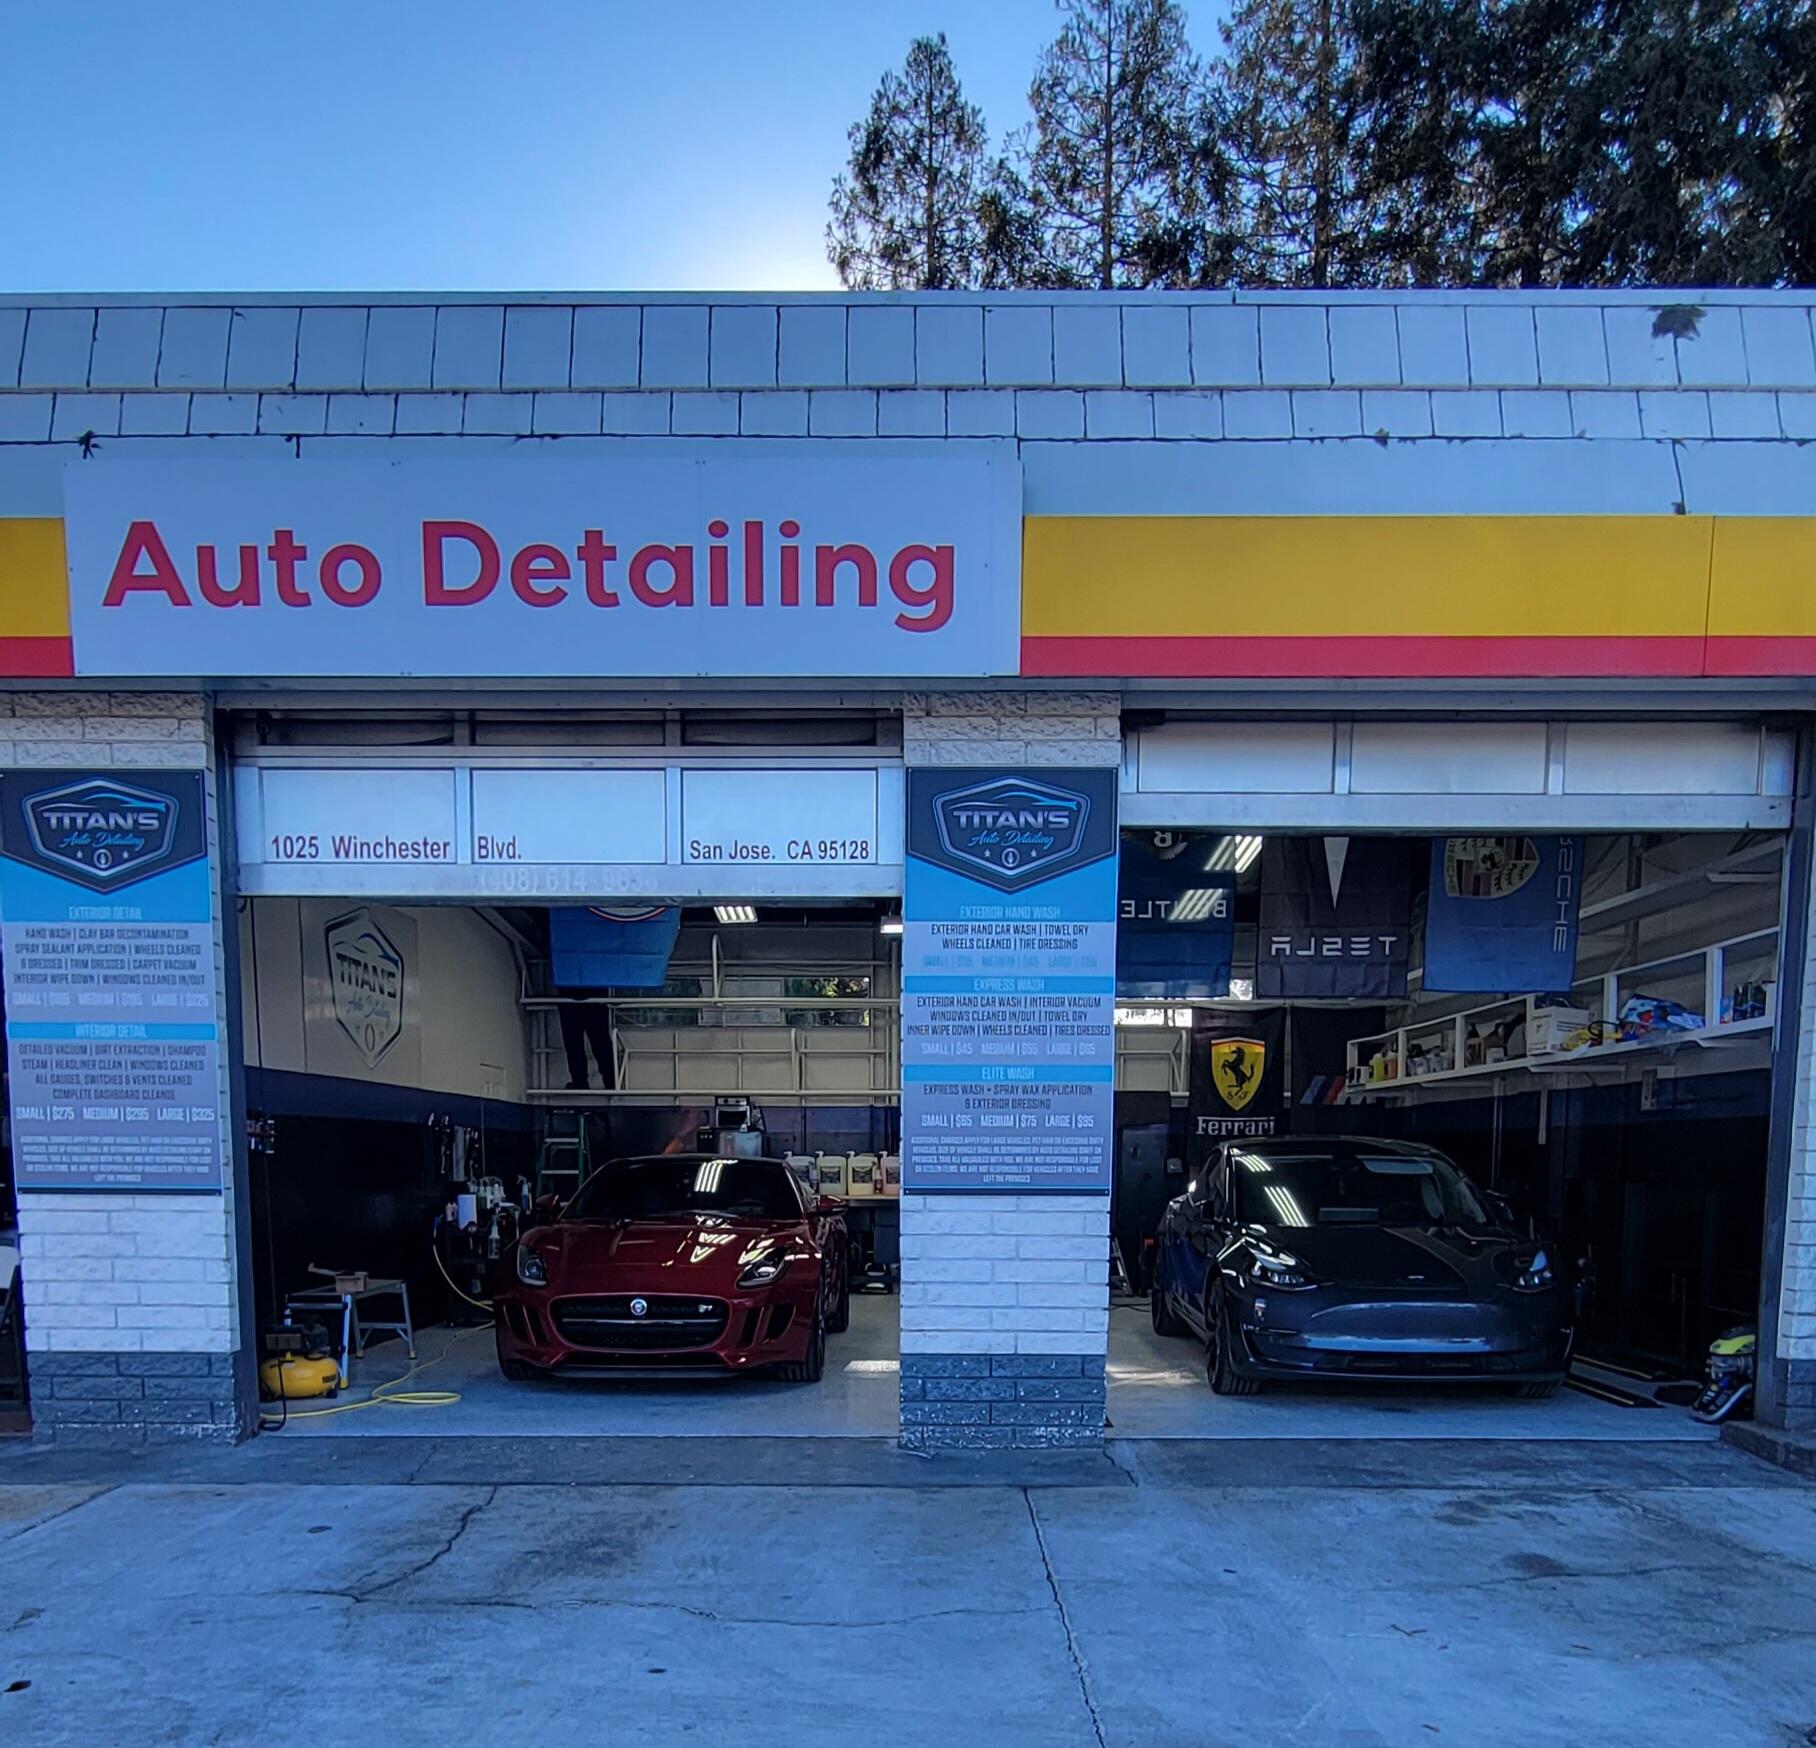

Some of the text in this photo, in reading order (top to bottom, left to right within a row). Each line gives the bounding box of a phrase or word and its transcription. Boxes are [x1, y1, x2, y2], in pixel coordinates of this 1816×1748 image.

[101, 519, 955, 632] Auto Detailing
[43, 812, 159, 830] TITAN'S
[953, 811, 1070, 828] TITAN'S
[968, 830, 1054, 849] Auto Detailing
[271, 835, 522, 859] 1025 Winchester Blvd.
[689, 840, 869, 860] San Jose. CA 95128
[960, 906, 1060, 918] EXTERIOR HAND WASH
[79, 929, 97, 939] CLAY
[100, 929, 114, 939] BAR
[931, 924, 1088, 935] EXTERIOR HAND CAR WASH TOWEL DRY
[77, 944, 126, 954] APPLICATION
[942, 938, 1078, 949] WHEELS CLEANED TIRE DRESSING
[70, 959, 89, 969] TRIM
[133, 959, 161, 969] CARPET
[14, 974, 47, 984] INTERIOR
[51, 974, 70, 984] WIPE
[974, 979, 1044, 991] EXPRESS WASH
[917, 997, 1101, 1007] EXTERIOR HAND CAR WASH INTERIOR VACUUM
[931, 1011, 1087, 1022] WINDOWS CLEANED IN/OUT TOWEL DRY
[75, 1024, 147, 1037] INTERIOR DETAIL
[907, 1025, 1110, 1036] INNER WIPE DOWN WHEELS CLEANED TIRES DRESSED
[22, 1060, 47, 1070] STEAM
[982, 1067, 1034, 1080] ELITE WASH
[35, 1074, 48, 1085] ALL
[53, 1089, 91, 1100] COMPLETE
[924, 1085, 959, 1096] EXPRESS
[961, 1085, 985, 1096] WASH
[994, 1085, 1020, 1096] SPRAY
[1022, 1085, 1039, 1096] WAX
[1041, 1085, 1092, 1096] APPLICATION
[973, 1099, 1009, 1110] EXTERIOR
[1012, 1099, 1051, 1110] DRESSING
[16, 1107, 45, 1120] SMALL
[52, 1107, 75, 1120] $275
[83, 1107, 119, 1120] MEDIUM
[157, 1107, 184, 1121] LARGE
[921, 1115, 949, 1127] SMALL
[981, 1115, 1014, 1127] MEDIUM
[1021, 1115, 1037, 1127] $75
[1045, 1115, 1070, 1127] LARGE
[1195, 1116, 1276, 1136] Ferrari
